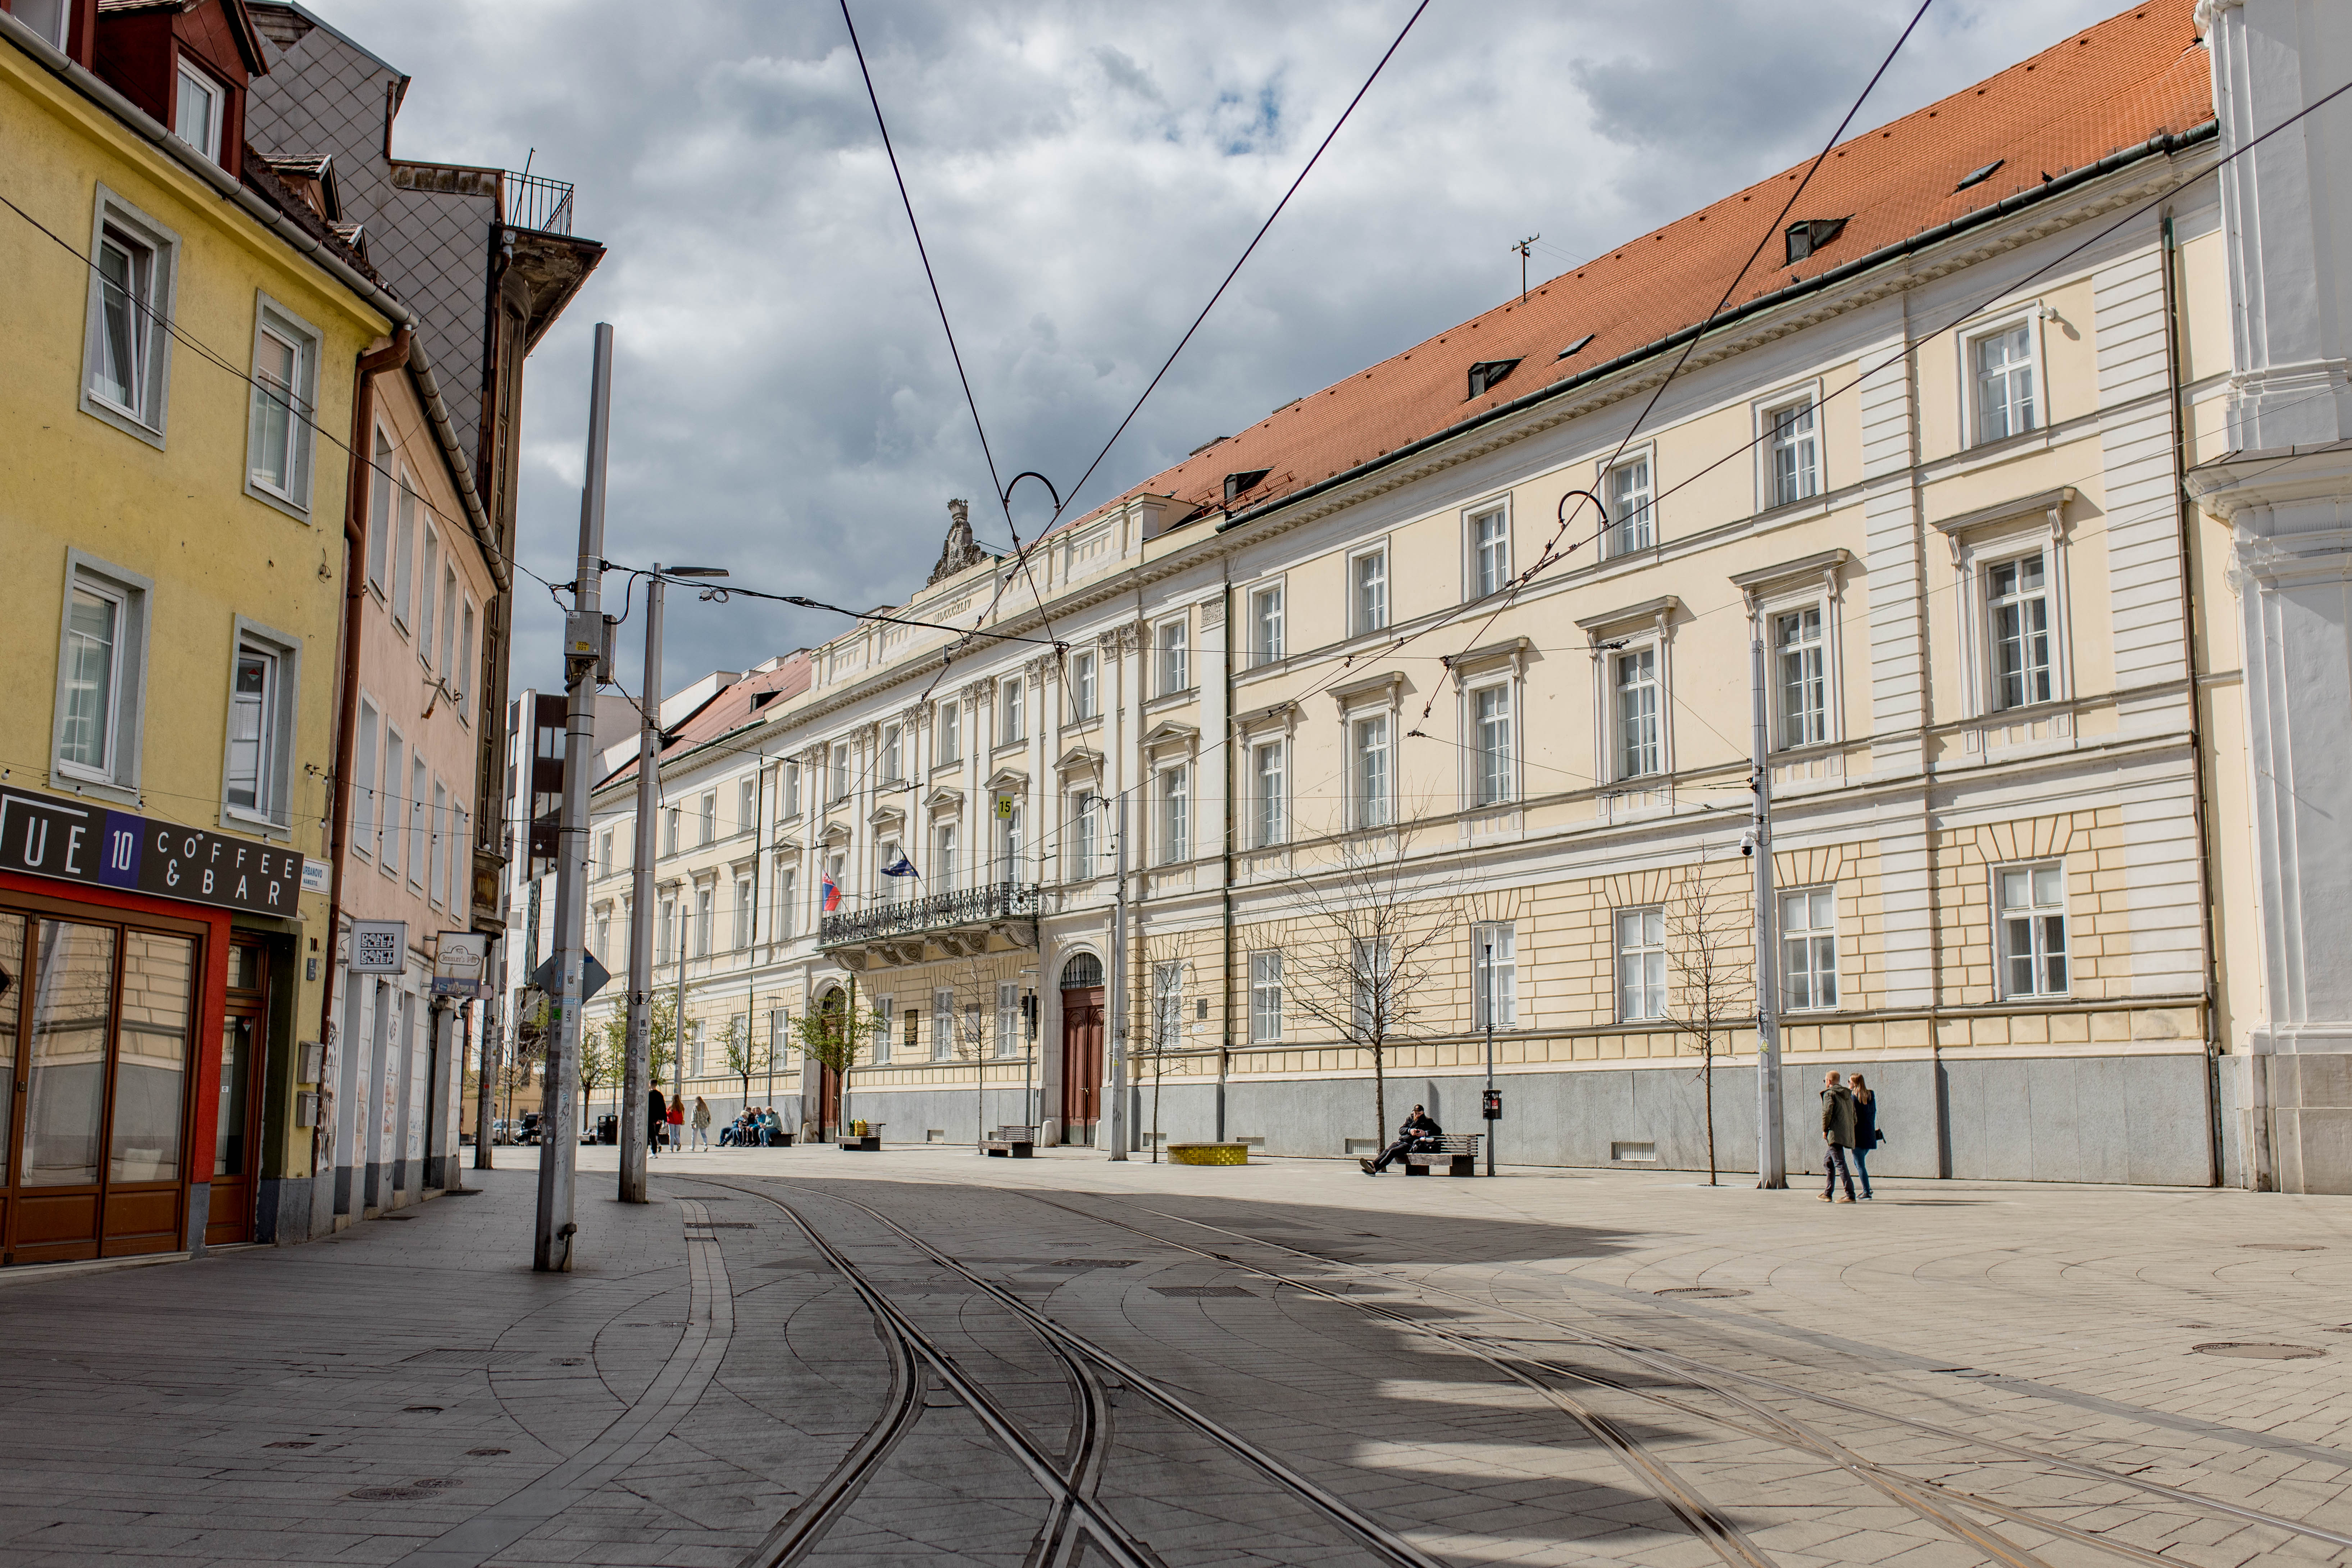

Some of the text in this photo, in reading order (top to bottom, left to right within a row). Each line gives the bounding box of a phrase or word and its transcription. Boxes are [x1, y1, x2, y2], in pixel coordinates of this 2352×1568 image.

[933, 598, 971, 624] MDCCCXLIV
[1000, 801, 1011, 813] 15
[112, 830, 133, 871] 10
[157, 832, 293, 879] COFFEE
[166, 859, 280, 905] & BAR
[302, 865, 323, 878] URBANOVO
[310, 937, 318, 952] 10
